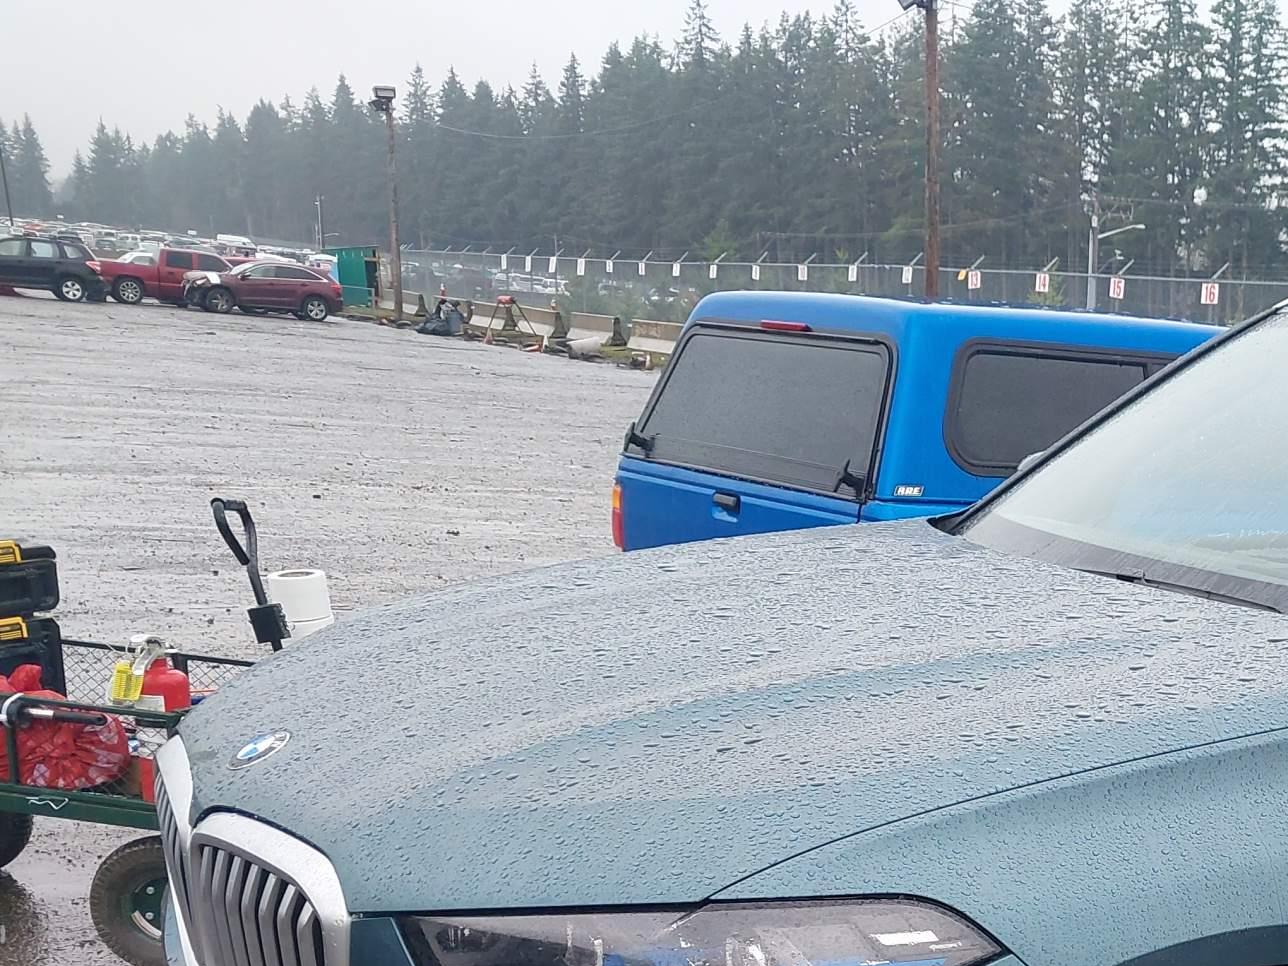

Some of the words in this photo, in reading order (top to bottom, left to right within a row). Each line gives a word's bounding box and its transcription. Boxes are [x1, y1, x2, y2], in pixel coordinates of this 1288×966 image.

[1038, 274, 1047, 290] 14
[1111, 280, 1122, 297] 15
[1204, 285, 1216, 303] 16
